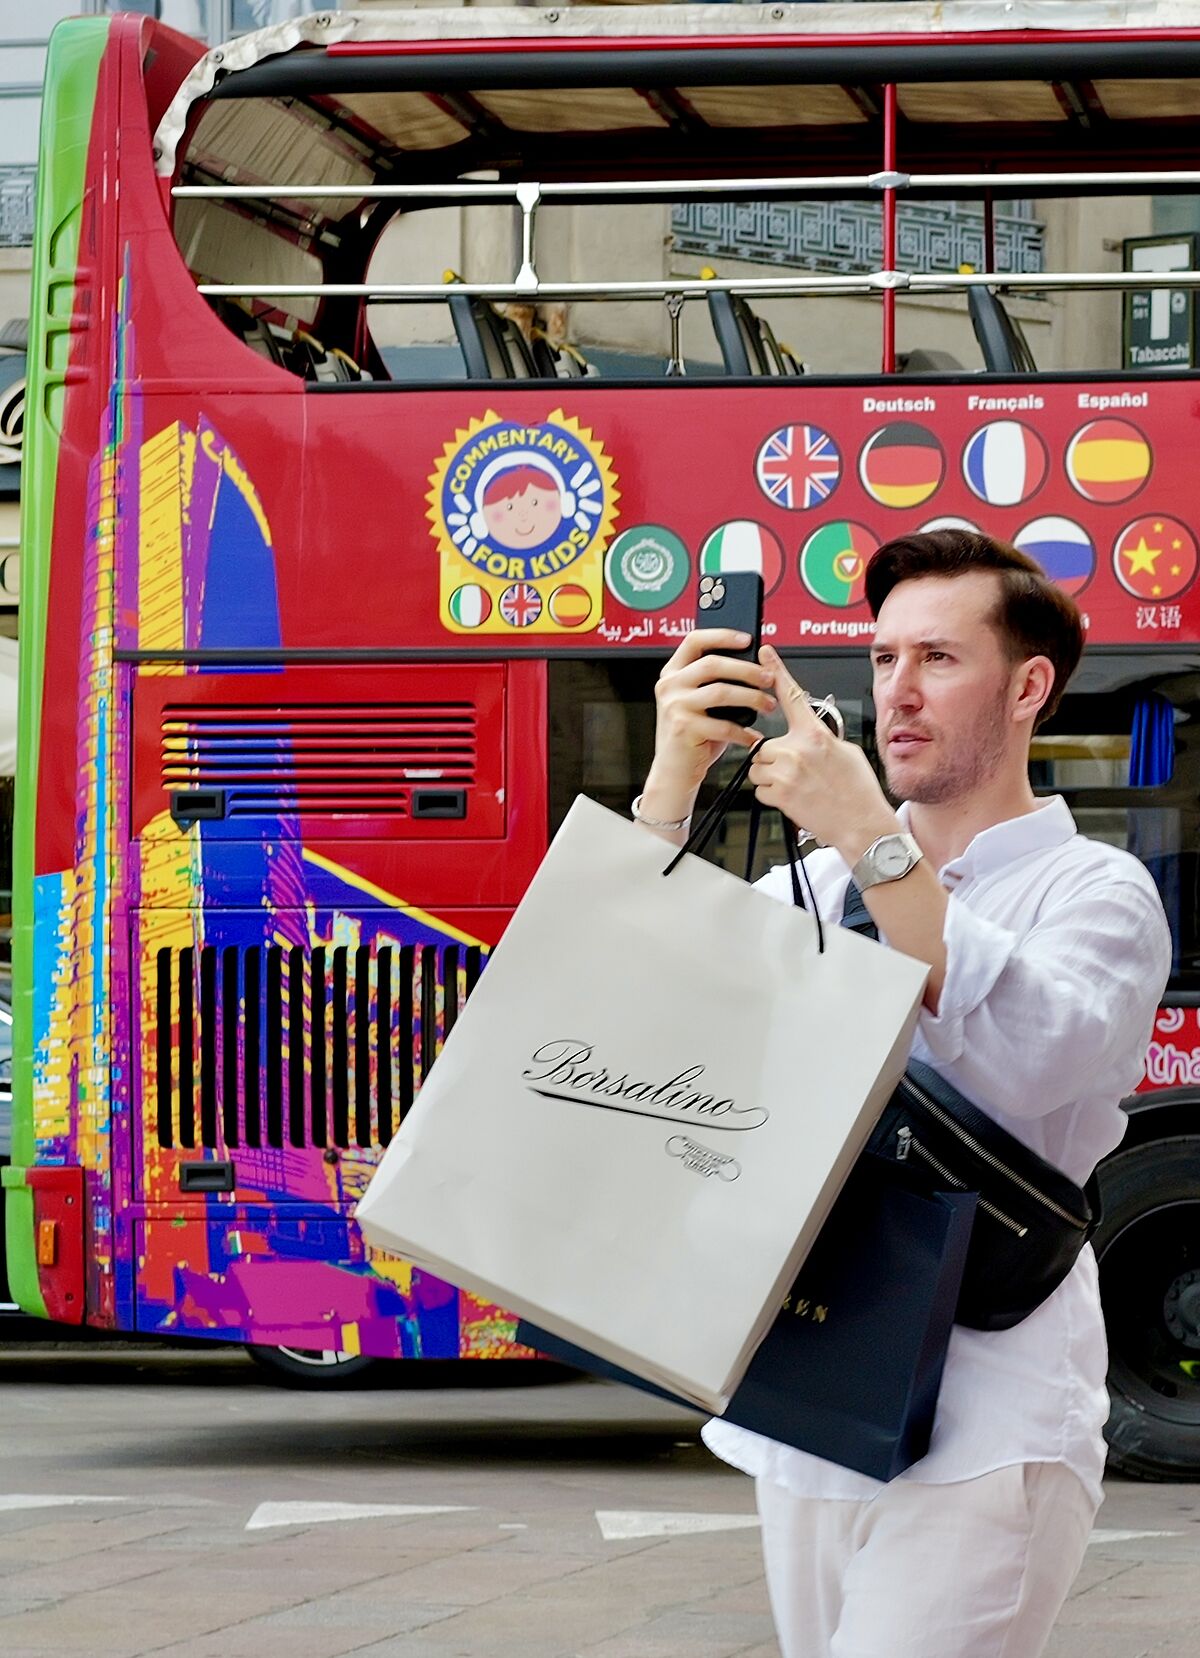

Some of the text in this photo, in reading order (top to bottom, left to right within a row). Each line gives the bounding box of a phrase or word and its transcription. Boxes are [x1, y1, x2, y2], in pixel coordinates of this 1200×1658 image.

[1130, 343, 1190, 363] Tabacchi
[863, 396, 936, 413] Deutsch
[967, 394, 1045, 413] Français
[1077, 392, 1149, 411] Español
[450, 428, 580, 495] COMMENTARY
[470, 526, 590, 580] FOR KIDS
[1135, 605, 1182, 630] 汉语
[799, 619, 878, 638] Portugue
[522, 1038, 770, 1131] Borsalino
